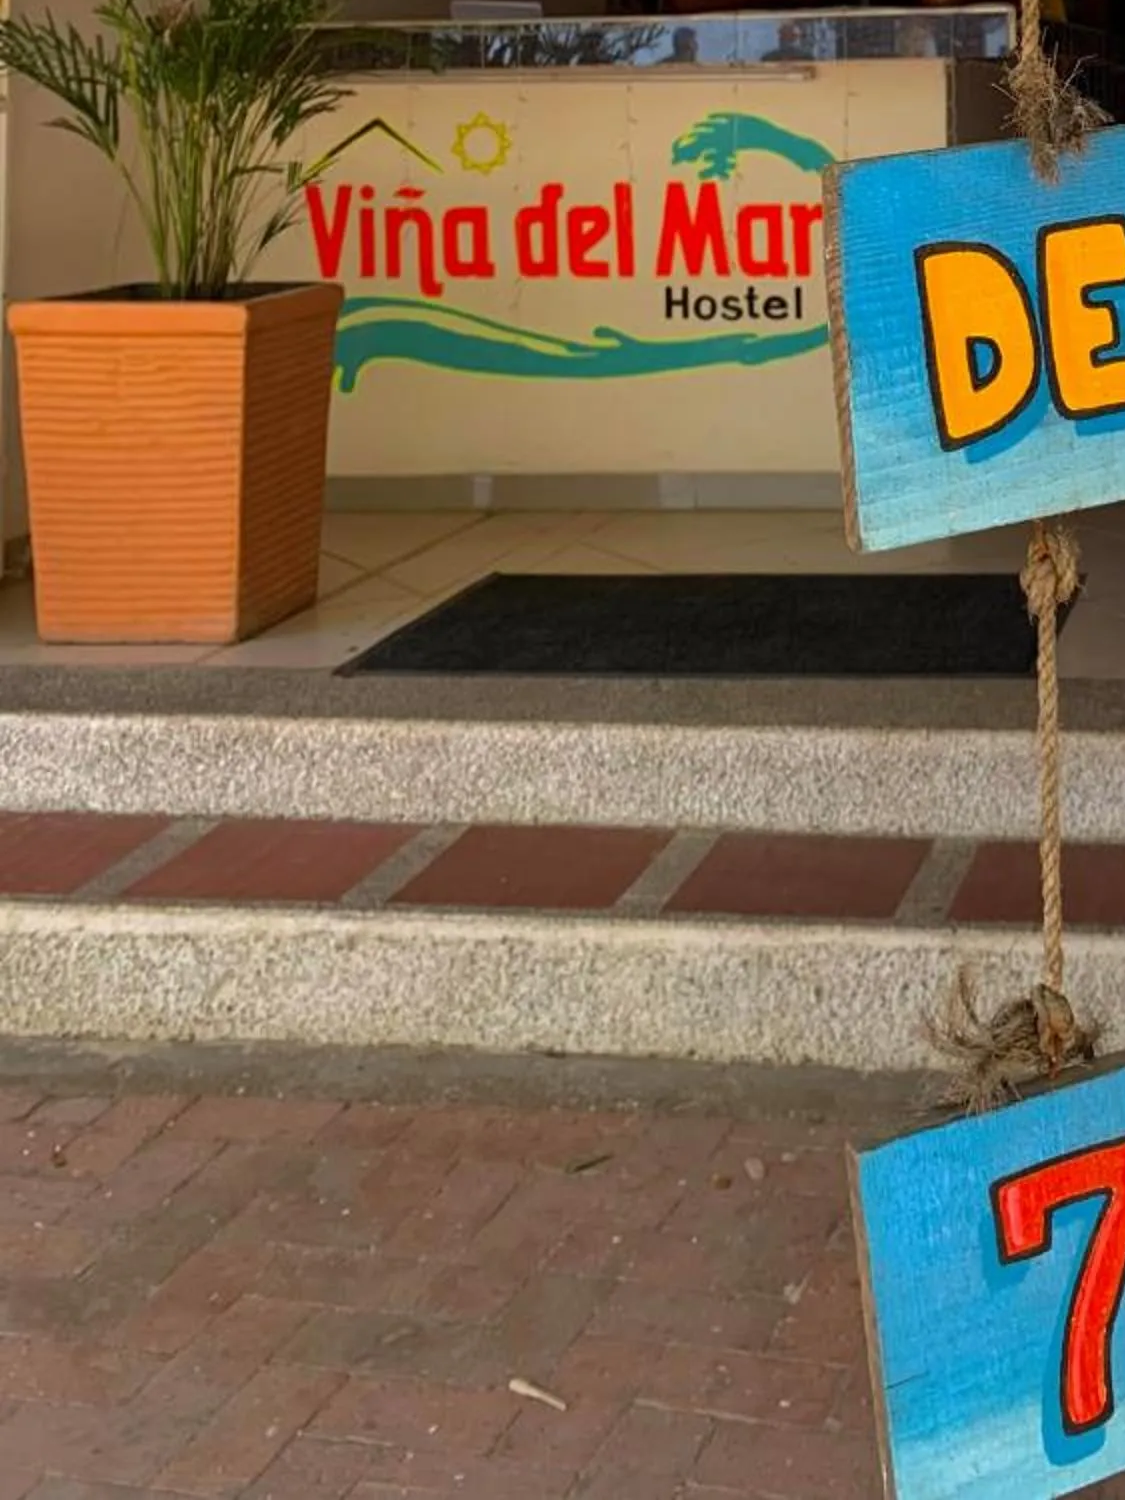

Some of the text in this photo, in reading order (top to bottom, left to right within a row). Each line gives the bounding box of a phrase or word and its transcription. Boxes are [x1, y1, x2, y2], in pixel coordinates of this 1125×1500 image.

[305, 180, 823, 298] Viña del Mar
[664, 285, 804, 322] Hostel
